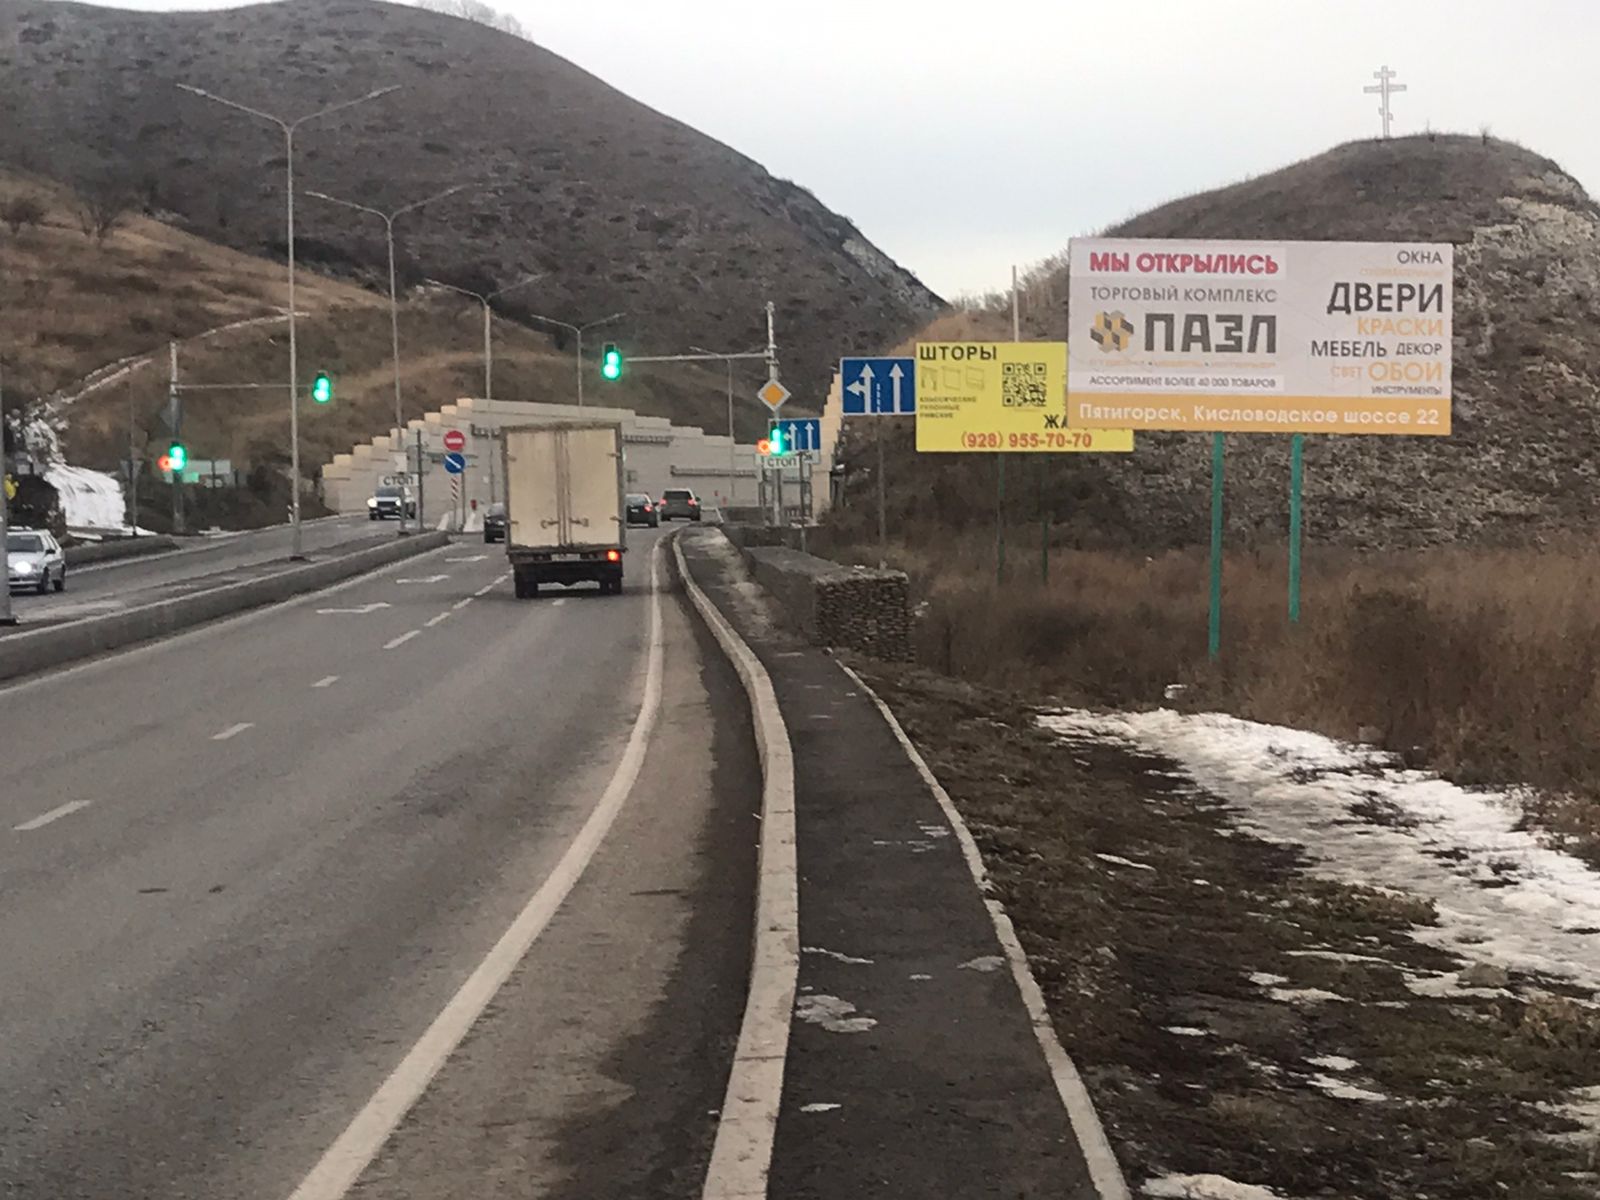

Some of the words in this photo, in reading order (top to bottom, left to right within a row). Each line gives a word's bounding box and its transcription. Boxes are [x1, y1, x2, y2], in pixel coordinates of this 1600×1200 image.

[1089, 252, 1130, 272] МЫ
[1136, 252, 1279, 275] ОТКРЫЛИСЬ
[1396, 250, 1443, 265] ОКНА
[1090, 284, 1178, 302] ТОРГОВЫЙ
[1184, 287, 1278, 303] КОМПЛЕКС
[1326, 281, 1443, 315] ДВЕРИ
[1144, 312, 1277, 354] ПАЗЛ
[1356, 317, 1444, 337] КРАСКИ
[919, 345, 998, 361] ШТОРЫ
[1311, 340, 1387, 358] МЕБЕЛЬ
[1396, 342, 1443, 356] ДЕКОР
[1368, 361, 1443, 382] ОБОИ
[1089, 375, 1163, 387] АССОРТИМЕНТ
[1164, 376, 1195, 388] БОЛЕЕ
[1211, 377, 1229, 388] 000
[1231, 378, 1276, 389] ТОВАРОВ
[1371, 385, 1443, 396] ИНСТРУМЕНТЫ
[1079, 403, 1187, 423] Пятигорск,
[1193, 405, 1338, 425] Кисловодское
[1343, 408, 1411, 425] шоссе
[1416, 408, 1440, 425] 22
[961, 431, 1003, 449] (928)
[1008, 432, 1093, 449] 955-70-70
